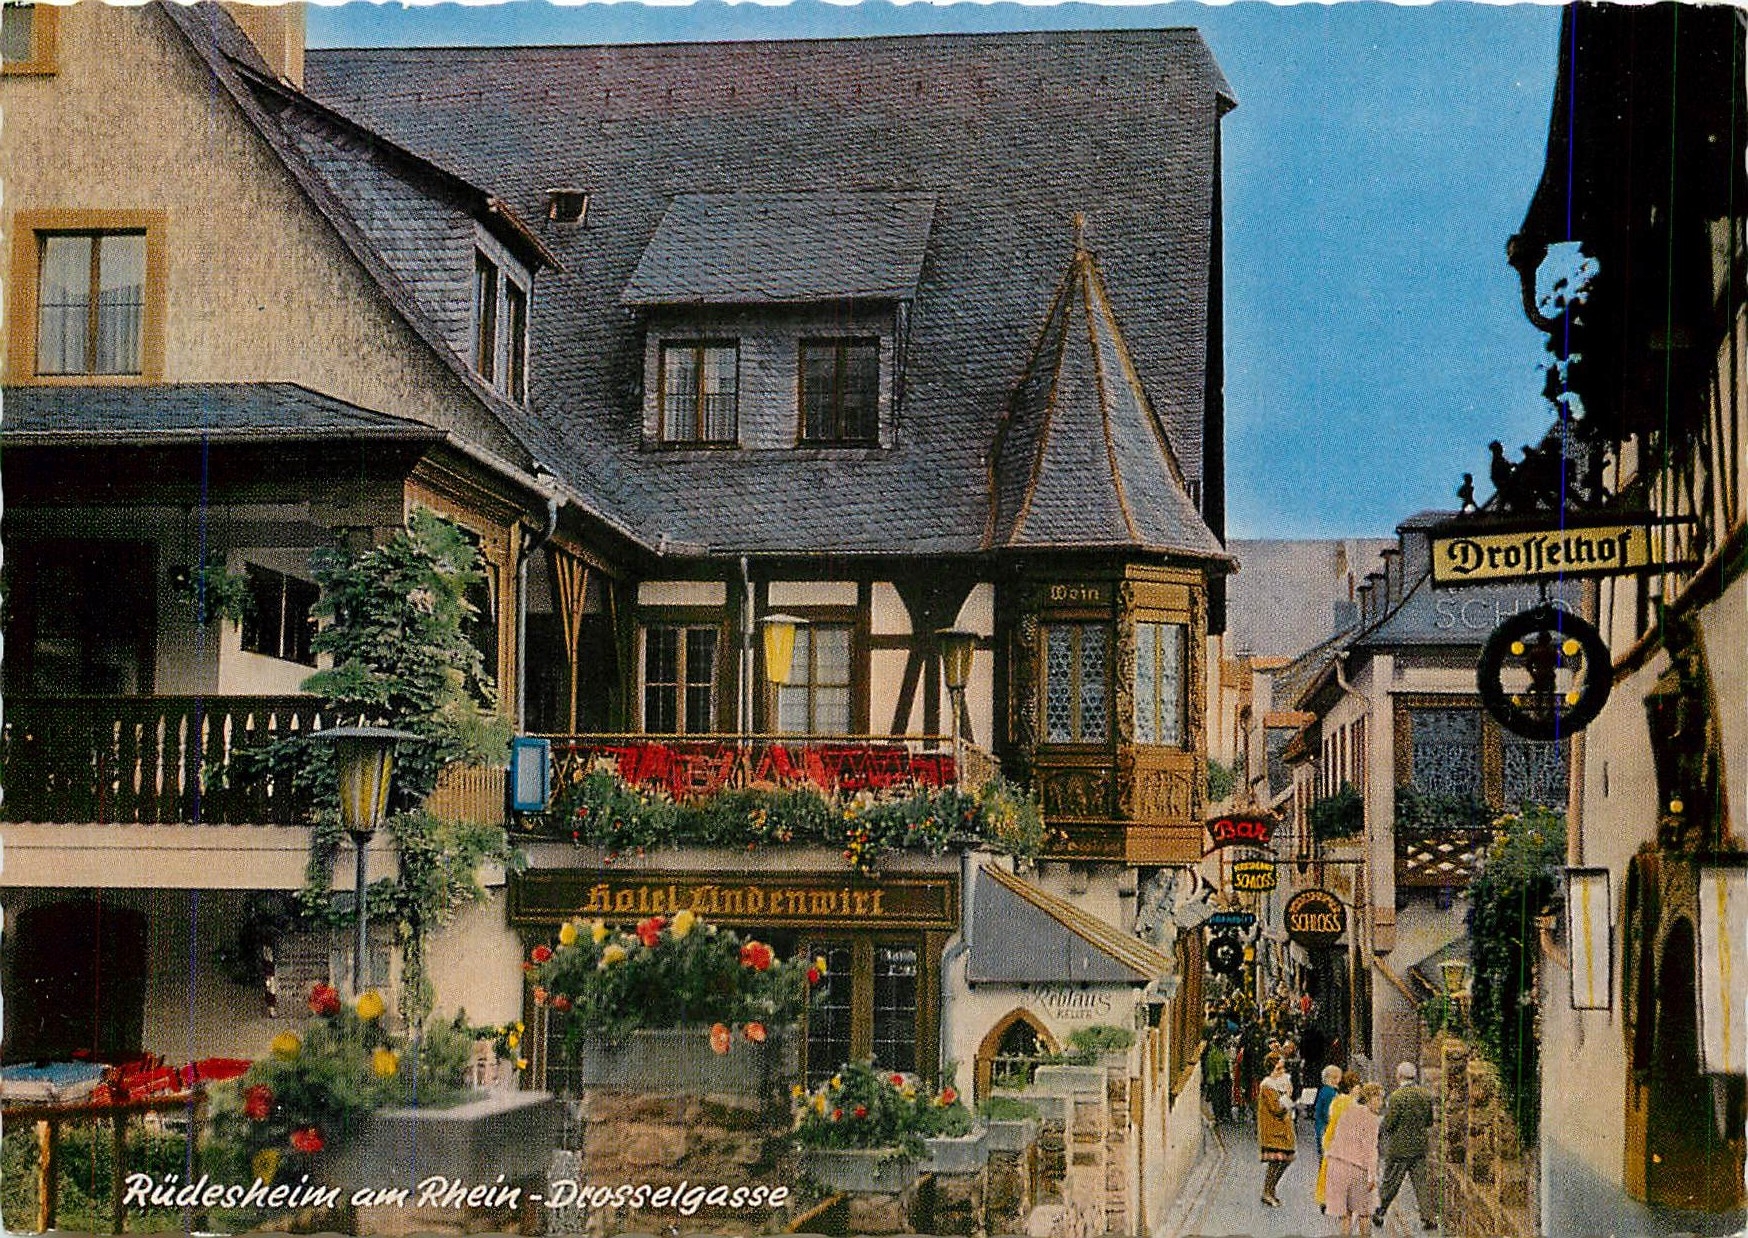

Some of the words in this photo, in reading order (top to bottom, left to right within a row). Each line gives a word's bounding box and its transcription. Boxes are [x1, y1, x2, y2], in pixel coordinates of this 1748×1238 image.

[1447, 528, 1633, 575] Drosselhof
[1049, 585, 1101, 601] Wein
[1213, 819, 1269, 843] Bar
[580, 883, 679, 913] Hotel
[689, 884, 886, 916] Lindenwirt
[1290, 912, 1342, 933] SCHLOSS
